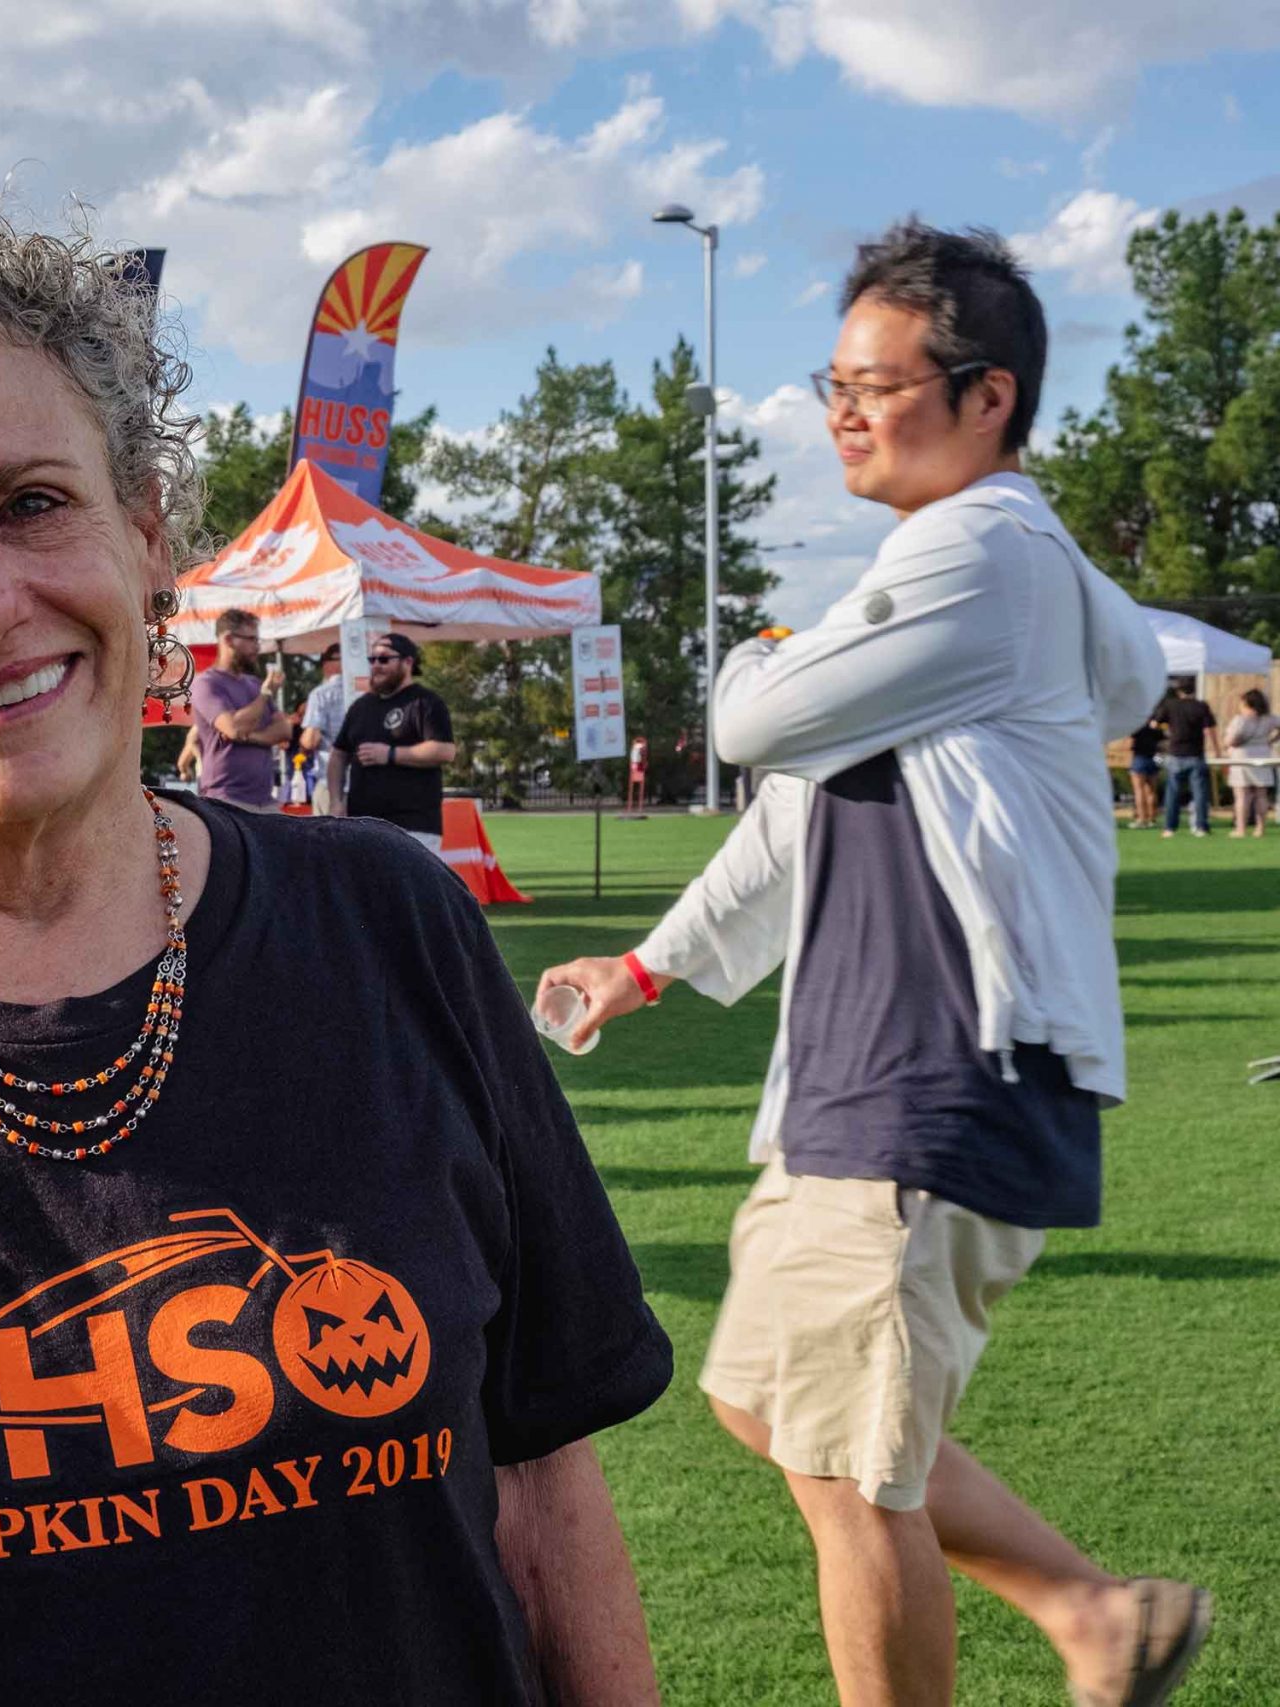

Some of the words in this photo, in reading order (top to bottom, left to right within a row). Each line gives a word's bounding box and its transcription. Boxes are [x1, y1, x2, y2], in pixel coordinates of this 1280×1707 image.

[300, 395, 390, 449] HUSS
[181, 1456, 323, 1531] DAY
[342, 1428, 452, 1496] 2019
